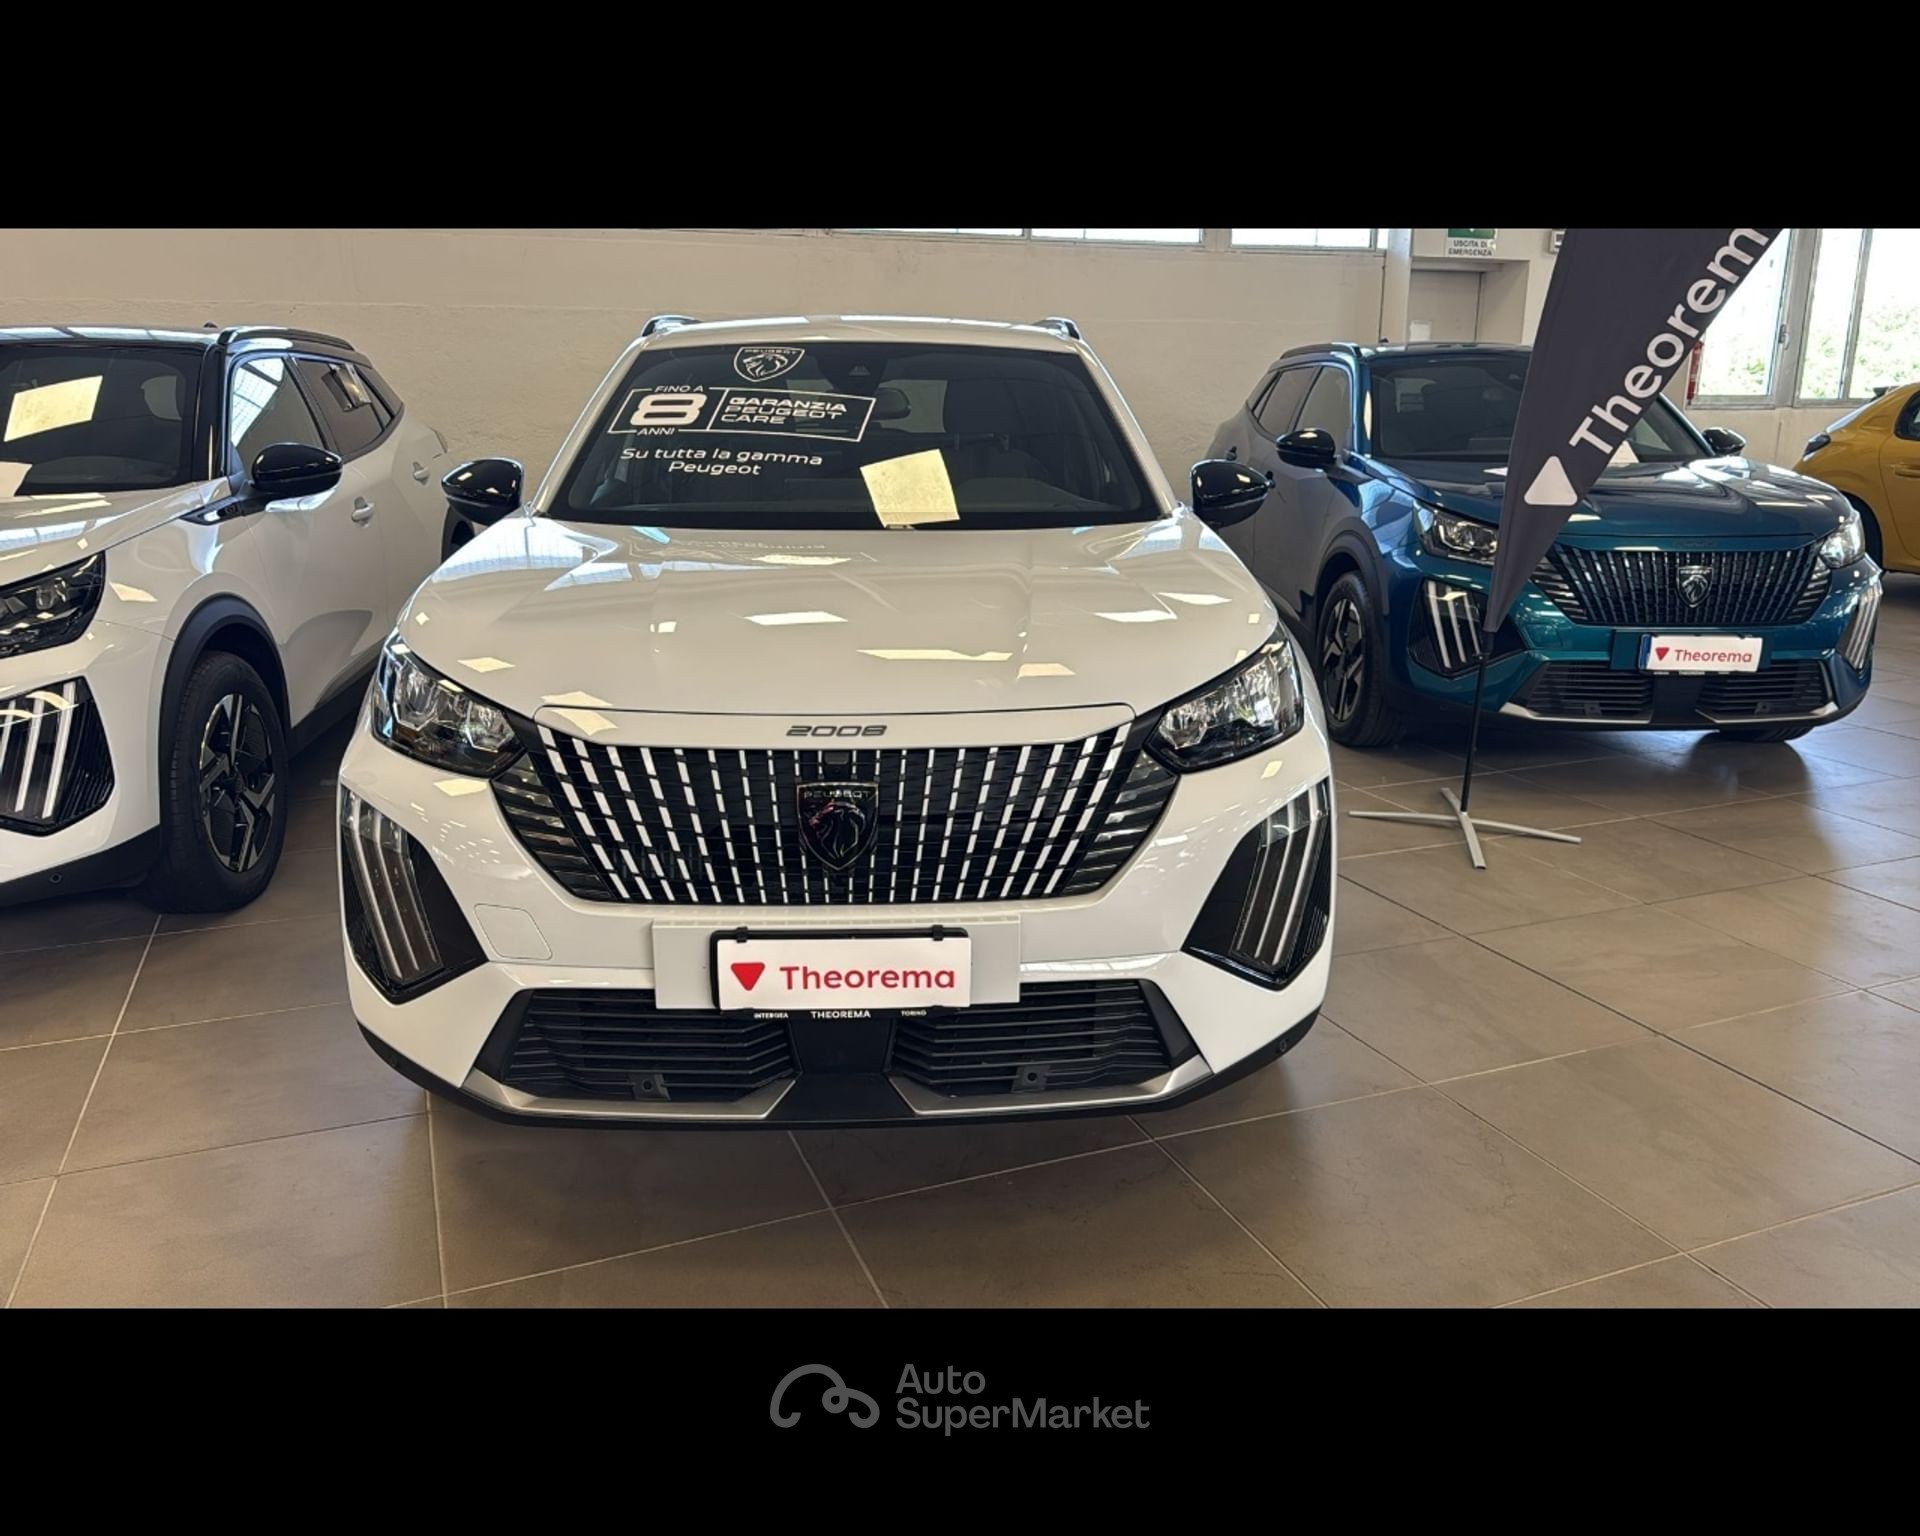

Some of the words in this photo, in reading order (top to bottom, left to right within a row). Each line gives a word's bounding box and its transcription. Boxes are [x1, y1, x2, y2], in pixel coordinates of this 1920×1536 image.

[654, 385, 692, 393] FINO
[630, 393, 707, 426] 8
[729, 397, 847, 412] GARANZIA
[721, 414, 786, 424] CARE
[725, 405, 842, 419] PEUGEOT
[637, 427, 676, 436] ANNI
[620, 448, 649, 459] Su
[654, 449, 706, 459] tutta
[712, 448, 731, 460] la
[736, 453, 823, 465] gamma
[668, 461, 762, 476] Peugeot
[1675, 649, 1752, 663] Theorema
[786, 725, 887, 737] 2008
[779, 965, 955, 990] Theorema
[810, 1010, 871, 1019] THEOREMA
